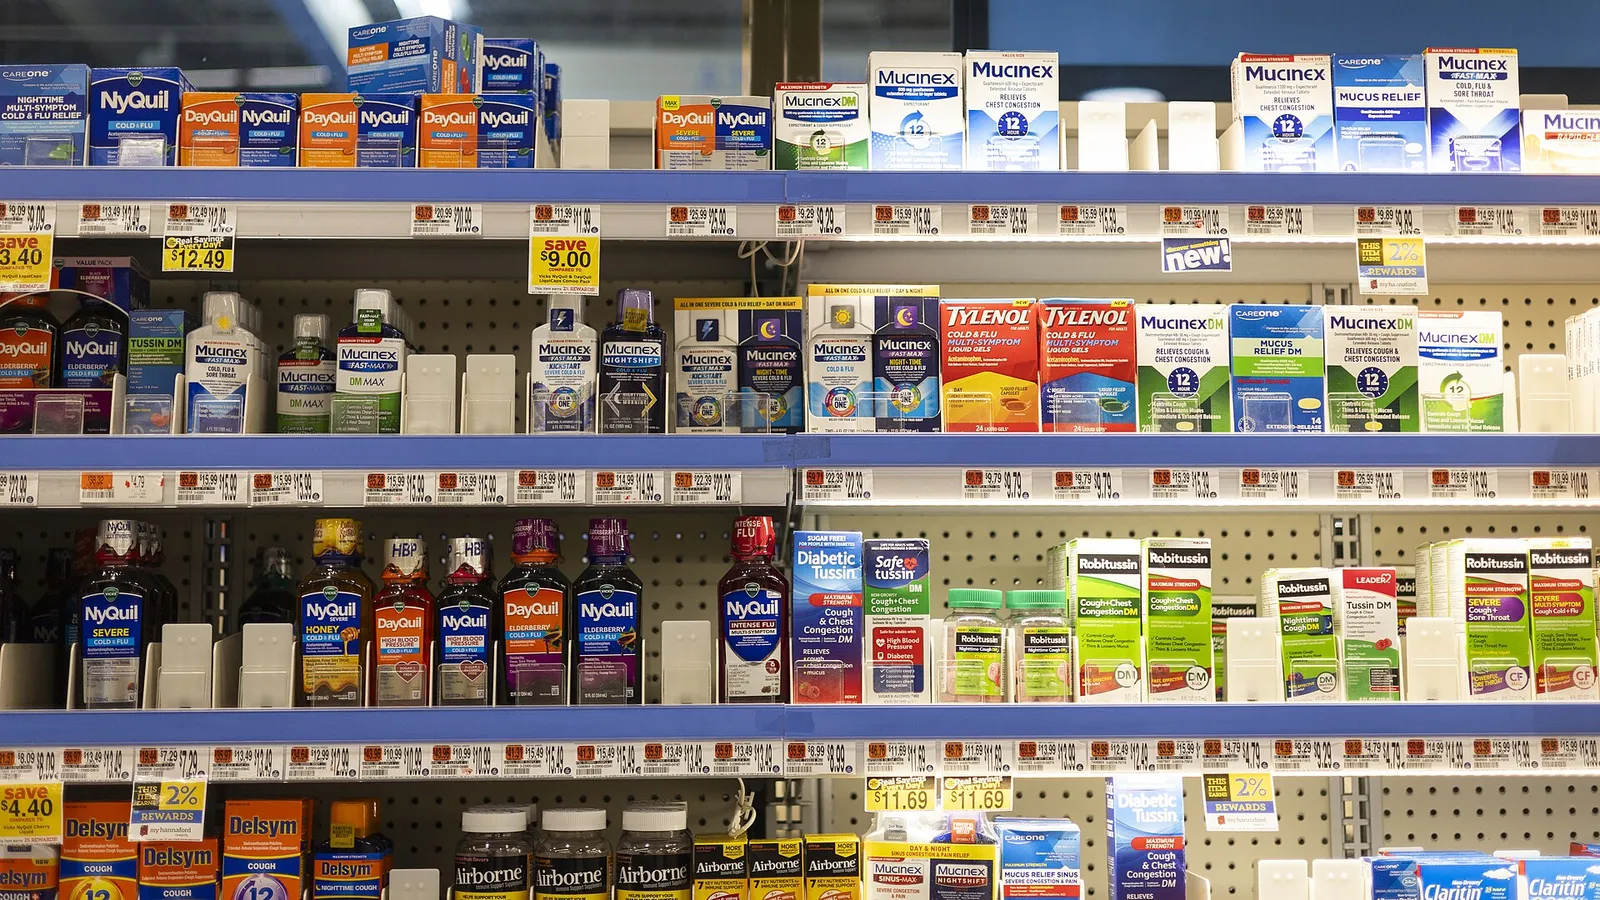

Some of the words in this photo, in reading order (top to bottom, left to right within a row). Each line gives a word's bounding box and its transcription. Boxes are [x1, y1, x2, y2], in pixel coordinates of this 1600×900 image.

[1439, 57, 1507, 70] Mucinex
[973, 63, 1052, 78] Mucinex
[1246, 66, 1325, 81] Mucinex
[879, 71, 954, 84] Mucinex
[100, 91, 169, 114] NyQuil
[1340, 93, 1379, 101] MUCUS
[1382, 93, 1421, 101] RELIEF
[185, 110, 237, 125] DayQuil
[243, 110, 290, 125] NyQuil
[305, 111, 356, 126] DayQuil
[361, 111, 408, 125] NyQuil
[424, 111, 476, 126] DayQuil
[481, 111, 528, 125] NyQuil
[663, 113, 713, 127] DayQuil
[719, 113, 766, 126] NyQuil
[1005, 118, 1019, 129] 12
[9, 205, 26, 216] $9.09
[102, 206, 120, 217] $13.49
[435, 208, 452, 218] $20.99
[555, 207, 572, 218] $11.99
[690, 209, 707, 219] $25.99
[798, 208, 814, 219] $9.29
[895, 208, 911, 219] $15.99
[1080, 208, 1097, 219] $15.59
[1377, 209, 1393, 220] $9.89
[545, 240, 586, 251] save
[171, 250, 224, 269] $12.49
[541, 252, 590, 268] $9.00
[1165, 239, 1230, 270] new!
[1369, 268, 1416, 276] REWARDS
[947, 307, 1030, 326] TYLENOL
[1046, 307, 1128, 327] TYLENOL
[131, 339, 165, 347] TUSSIN
[606, 344, 659, 354] Mucinex
[880, 341, 931, 350] Mucinex
[66, 341, 117, 358] NyQuil
[196, 346, 247, 357] Mucinex
[342, 349, 396, 360] Mucinex
[539, 345, 591, 354] Mucinex
[747, 351, 797, 360] Mucinex
[815, 345, 866, 354] Mucinex
[350, 377, 361, 386] DM
[363, 378, 385, 386] MAX
[1176, 374, 1191, 386] 12
[1366, 374, 1379, 385] 12
[393, 544, 417, 557] HBP
[798, 551, 855, 565] Diabetic
[875, 556, 904, 569] Safe
[1150, 553, 1208, 564] Robitussin
[1466, 558, 1524, 569] Robitussin
[1532, 553, 1589, 564] Robitussin
[1079, 559, 1137, 570] Robitussin
[815, 566, 857, 579] Tussin
[875, 570, 915, 580] tussin
[1279, 583, 1327, 594] Robitussin
[307, 603, 355, 620] NyQuil
[507, 603, 558, 619] DayQuil
[581, 603, 633, 620] NyQuil
[727, 601, 778, 619] NyQuil
[1347, 602, 1375, 610] Tussin
[85, 605, 138, 624] NyQuil
[825, 609, 853, 618] Cough
[378, 617, 421, 630] DayQuil
[443, 615, 486, 629] NyQuil
[828, 617, 853, 625] Chest
[93, 628, 129, 636] SEVERE
[804, 625, 853, 635] Congestion
[961, 636, 998, 644] Robitussin
[1030, 636, 1066, 644] Robitussin
[5, 787, 48, 799] save
[166, 786, 198, 805] 2%
[874, 791, 927, 809] $11.69
[951, 790, 1003, 809] $11.69
[1118, 793, 1176, 808] Diabetic
[1, 798, 52, 817] $4.40
[1132, 808, 1177, 823] Tussin
[230, 817, 296, 836] Delsym
[144, 848, 211, 867] Delsym
[322, 862, 371, 878] Delsym
[697, 862, 744, 873] Airborne
[752, 861, 800, 872] Airborne
[875, 865, 922, 874] Mucinex
[938, 866, 985, 876] Mucinex
[455, 868, 522, 885] Airborne
[619, 866, 687, 883] Airborne
